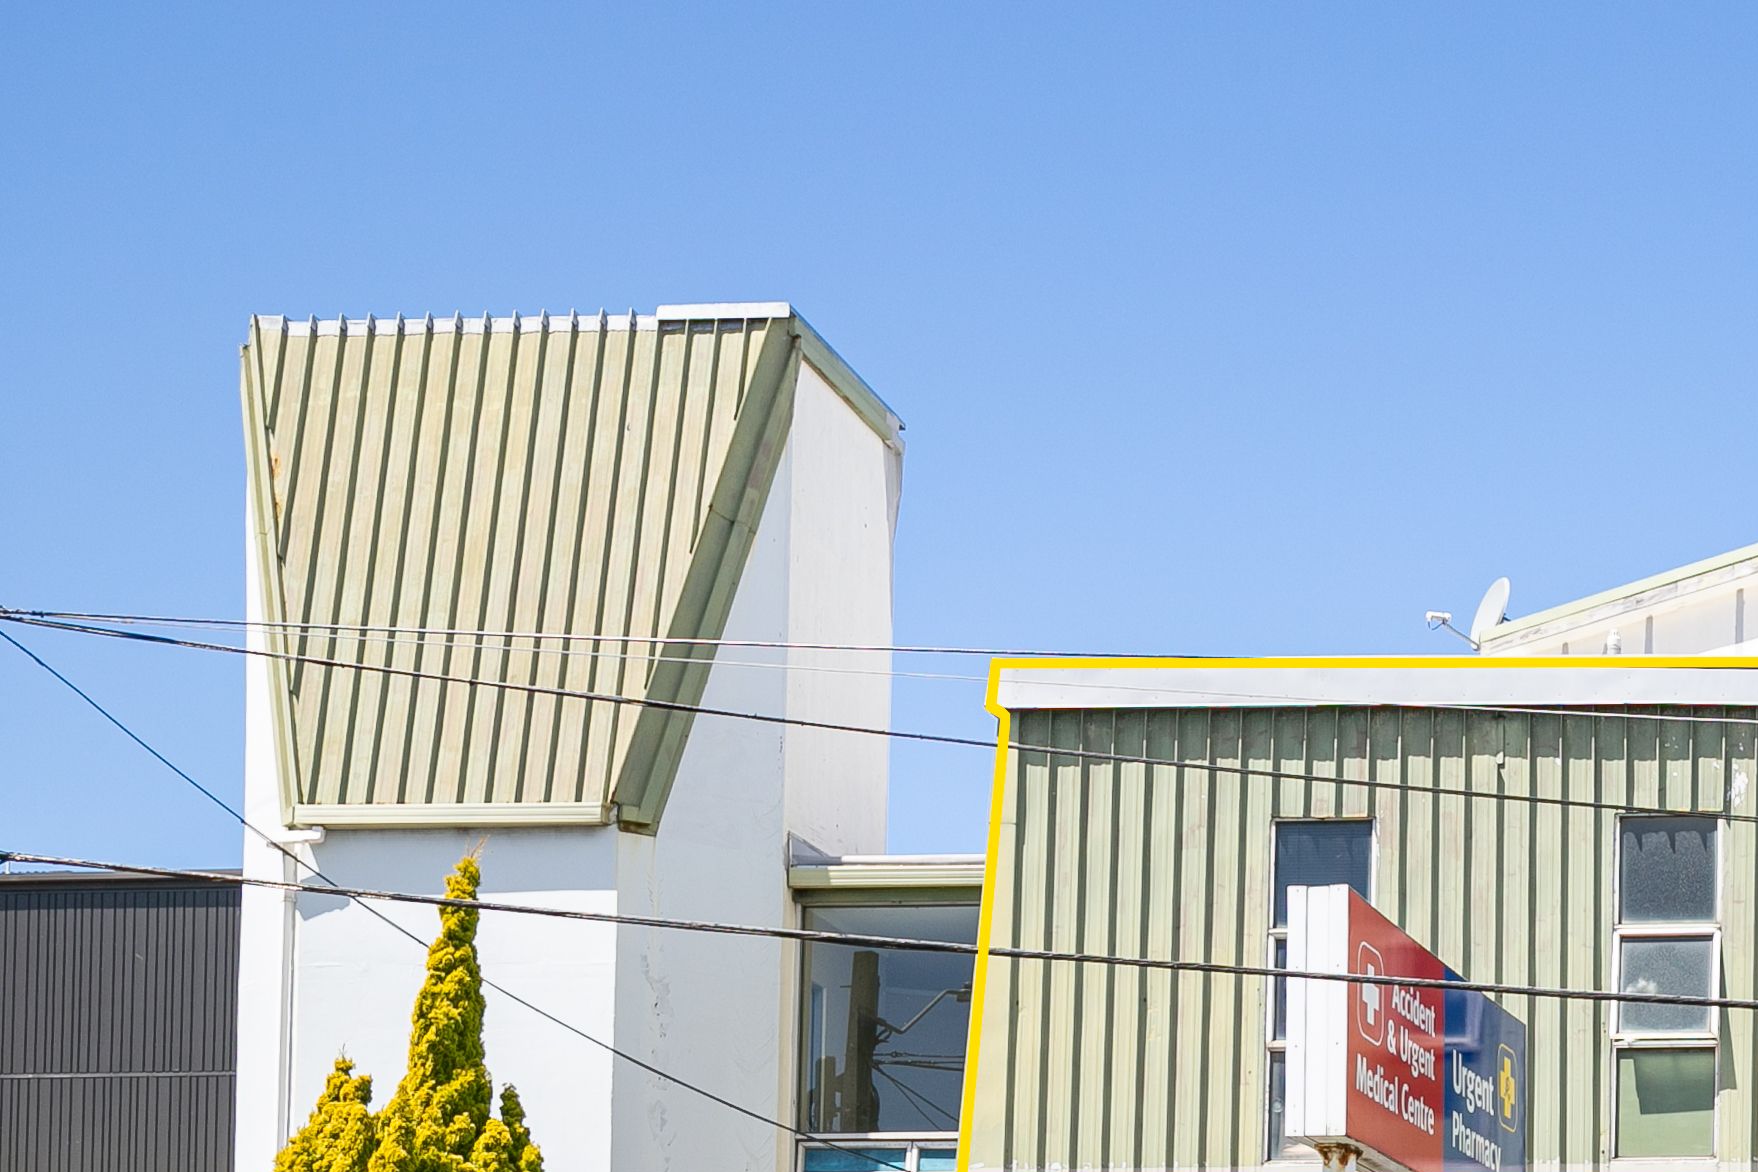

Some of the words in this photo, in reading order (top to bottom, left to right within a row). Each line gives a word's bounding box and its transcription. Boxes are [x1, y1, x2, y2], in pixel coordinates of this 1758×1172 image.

[1392, 984, 1436, 1038] Accident
[1387, 1023, 1397, 1056] &
[1400, 1025, 1436, 1081] Urgent
[1355, 1053, 1399, 1115] Medical
[1401, 1083, 1435, 1136] Centre
[1452, 1050, 1494, 1117] Urgent
